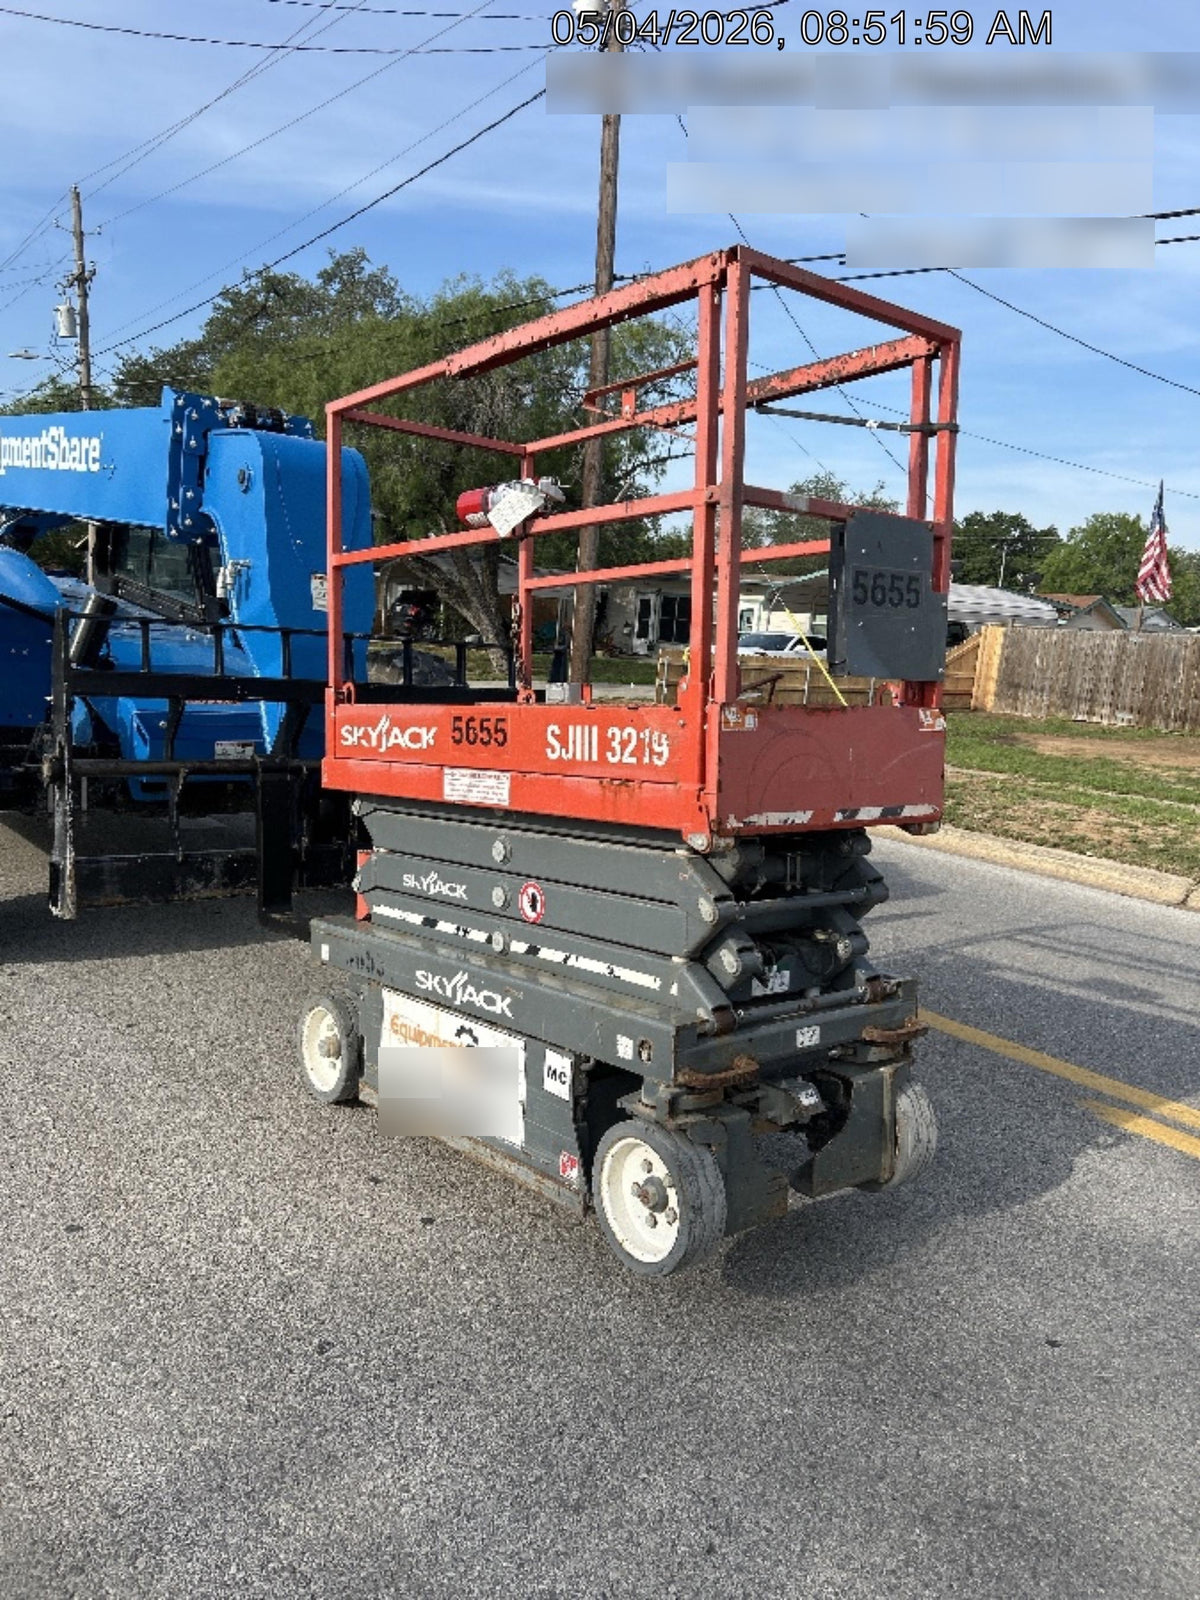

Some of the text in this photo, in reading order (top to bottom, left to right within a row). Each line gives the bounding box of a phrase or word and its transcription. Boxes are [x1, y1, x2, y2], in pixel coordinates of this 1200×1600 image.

[853, 570, 921, 608] 5655
[340, 713, 438, 752] SKYJACK
[451, 715, 508, 748] 5655
[606, 726, 671, 767] 3219
[402, 870, 469, 901] SKYJACK
[415, 970, 515, 1020] SKYJACK
[546, 1064, 568, 1086] MC
